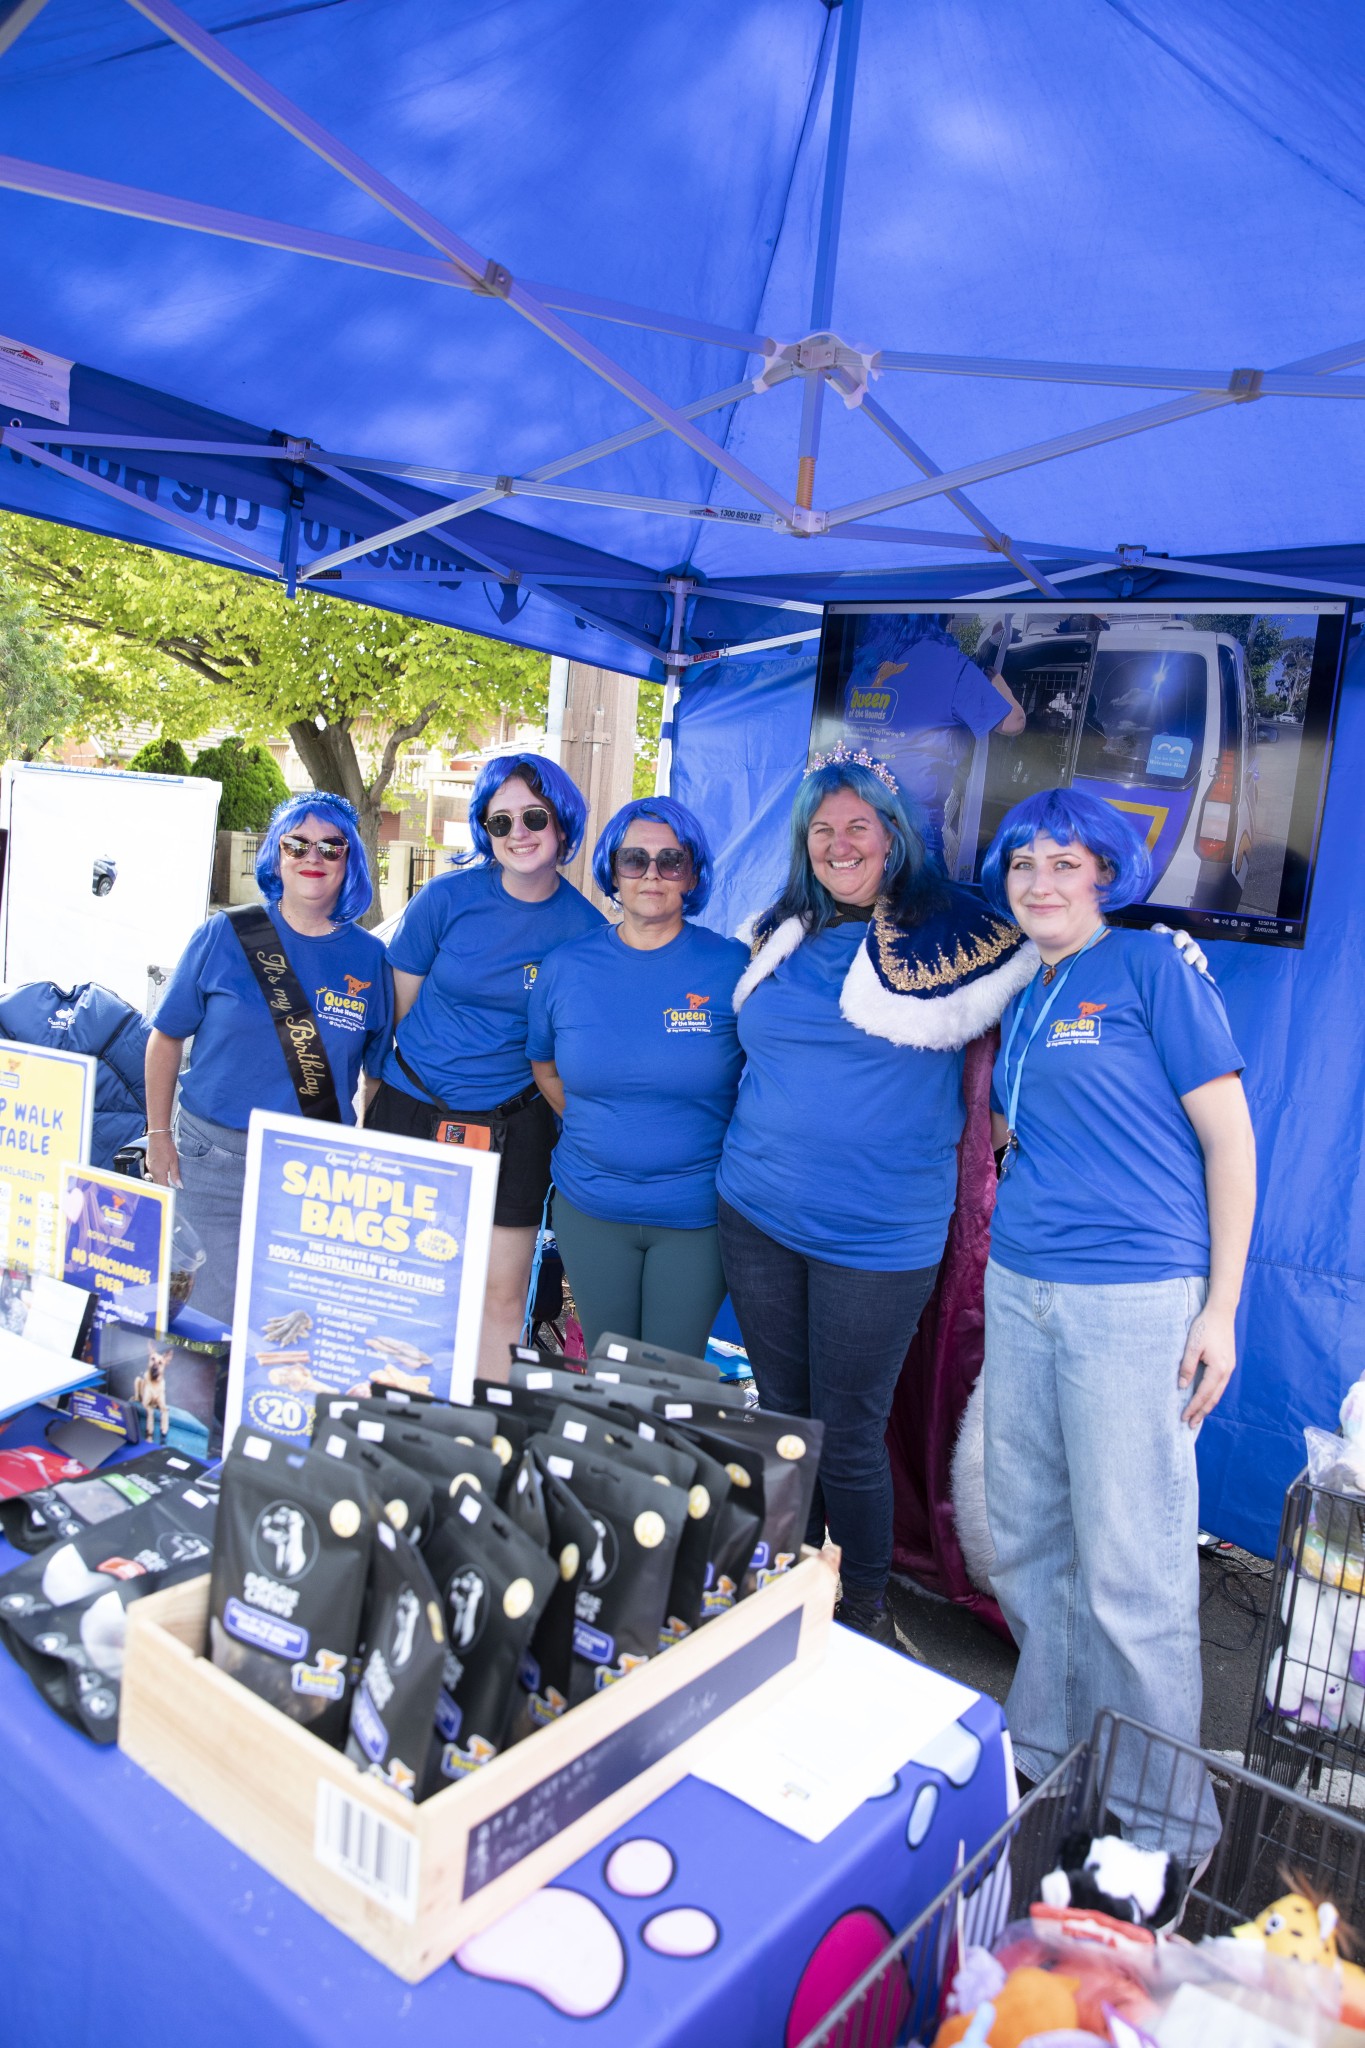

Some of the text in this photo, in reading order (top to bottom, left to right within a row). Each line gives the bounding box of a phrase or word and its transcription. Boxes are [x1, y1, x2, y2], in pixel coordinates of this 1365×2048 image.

[720, 509, 735, 518] 1300
[736, 511, 748, 520] 850
[749, 513, 762, 522] 832
[850, 690, 891, 710] Queen
[324, 991, 365, 1014] Queen
[332, 1006, 344, 1014] the
[344, 1009, 363, 1021] Hounds
[670, 1011, 706, 1022] Queen
[1055, 1019, 1095, 1033] Queen
[270, 988, 292, 1012] my
[285, 1015, 325, 1097] Birthday
[15, 1101, 64, 1131] WALK
[281, 1160, 439, 1222] SAMPLE
[300, 1198, 411, 1253] BAGS
[308, 1241, 325, 1254] THE
[325, 1245, 369, 1262] ULTIMATE
[71, 1247, 88, 1265] NO
[87, 1252, 152, 1287] SURCHARGES
[268, 1243, 446, 1293] 100% AUSTRALIAN PROTEINS
[258, 1397, 302, 1430] $20
